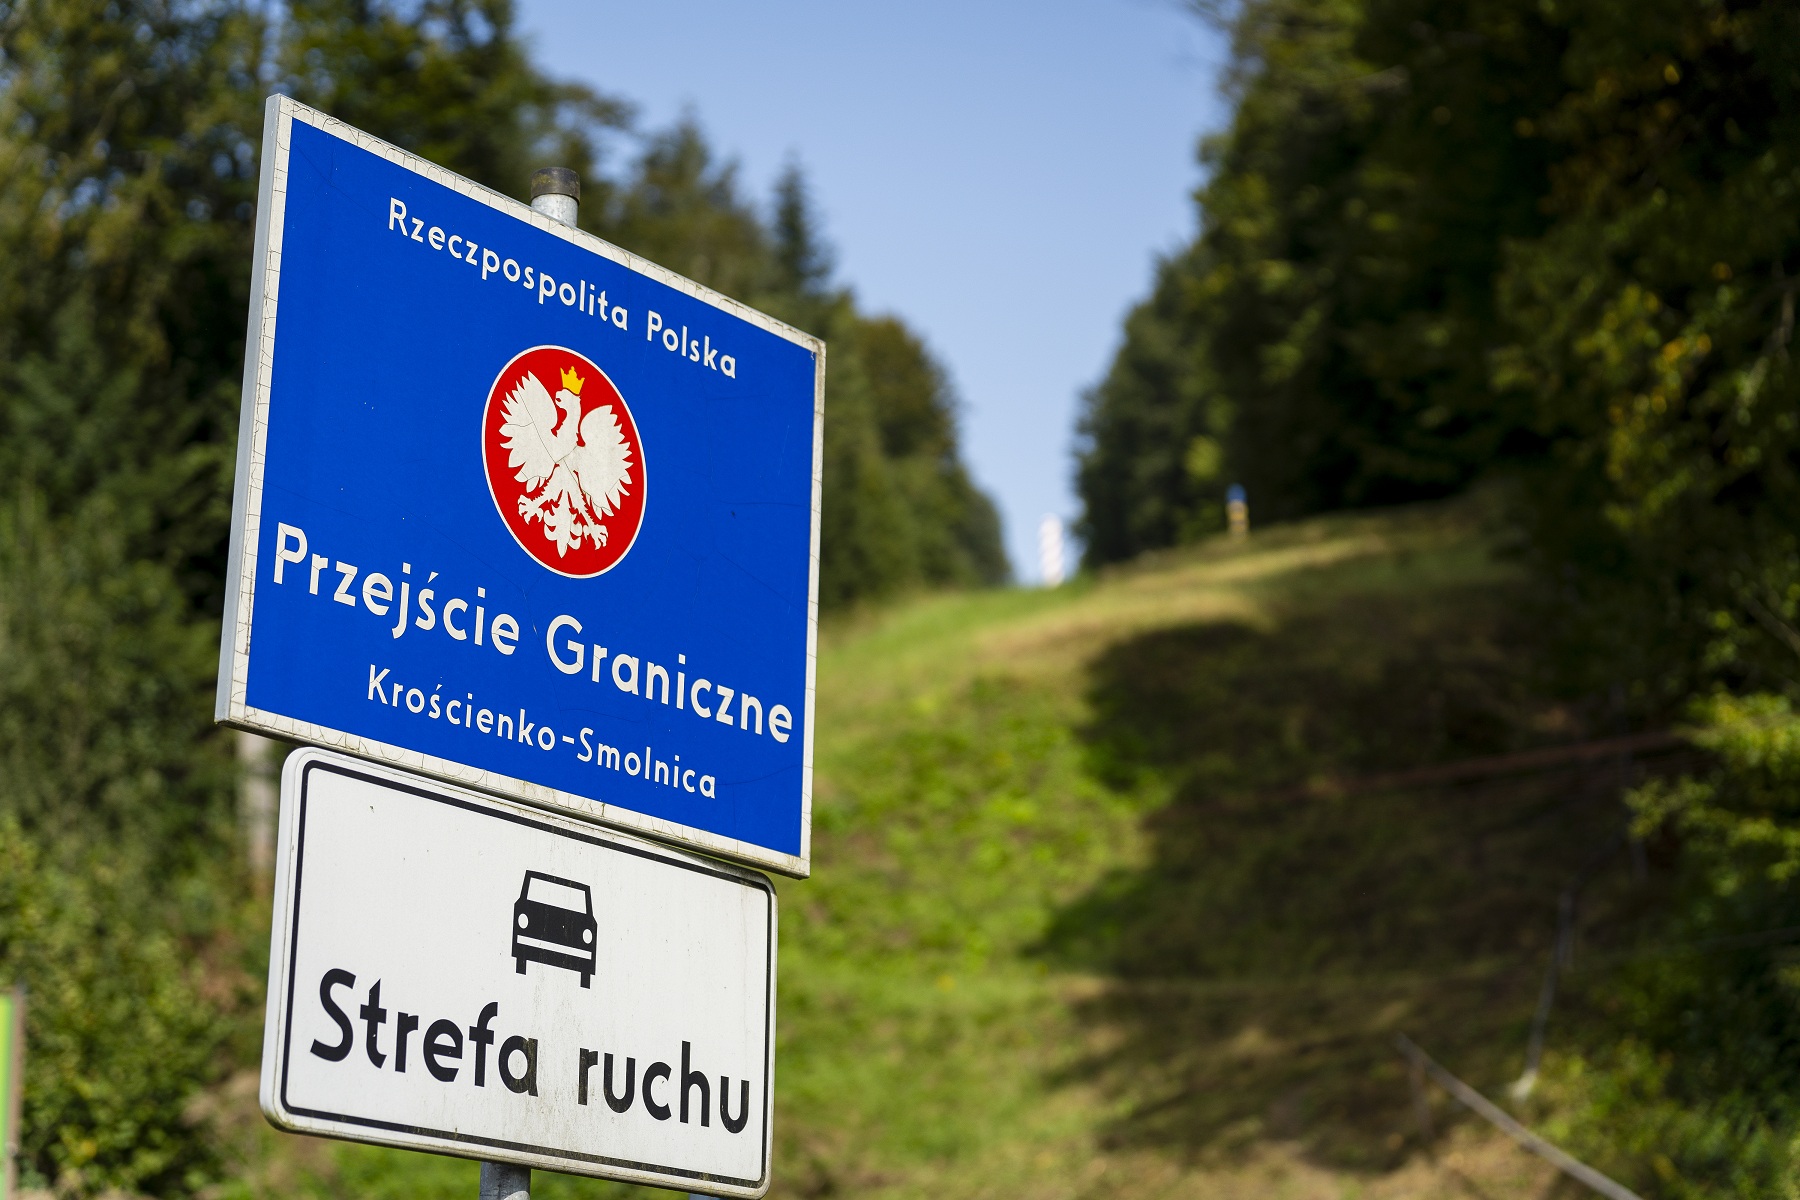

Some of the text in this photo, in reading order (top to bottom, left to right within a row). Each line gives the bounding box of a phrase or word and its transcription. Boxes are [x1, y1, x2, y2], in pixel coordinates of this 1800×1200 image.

[388, 196, 736, 379] Rzeczpospolita Polska
[273, 521, 793, 744] Przejście Graniczne
[367, 663, 716, 799] Krościenko-Smolnica
[310, 968, 750, 1134] Strefa ruchu
